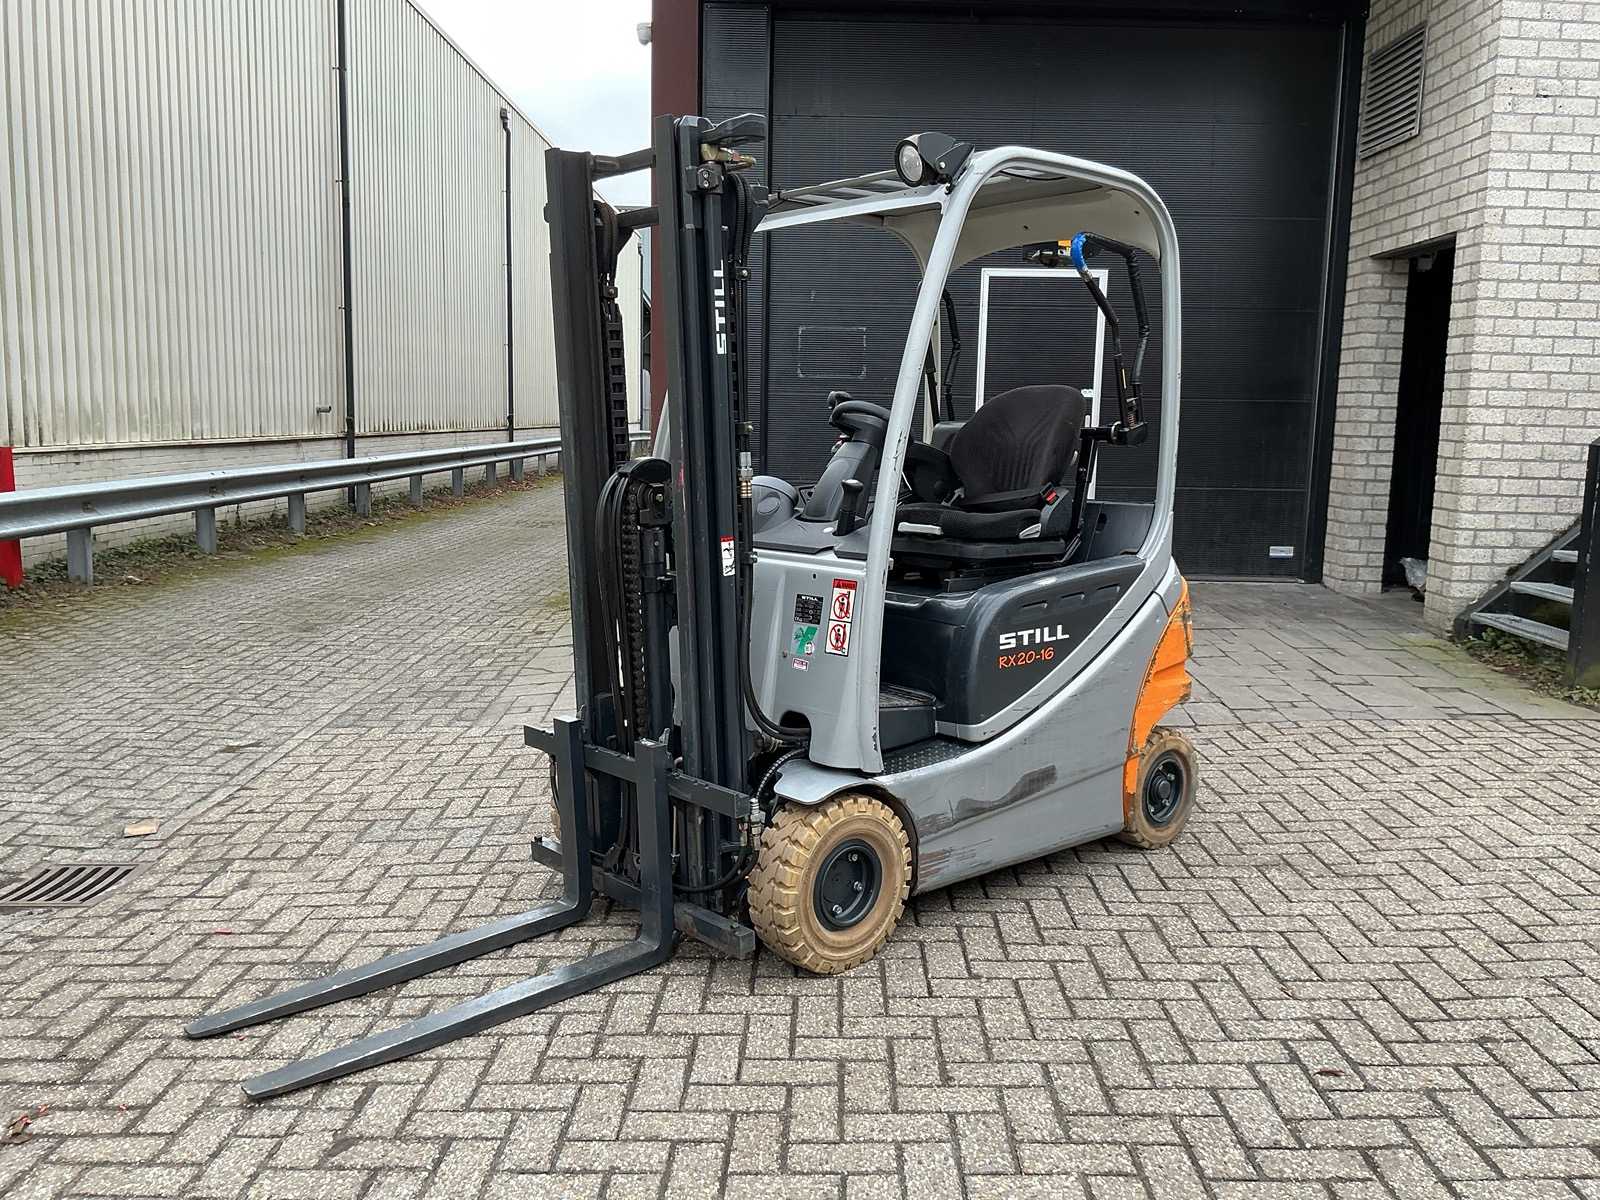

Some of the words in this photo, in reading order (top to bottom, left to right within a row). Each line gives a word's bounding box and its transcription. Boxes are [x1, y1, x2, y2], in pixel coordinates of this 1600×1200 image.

[713, 259, 727, 354] STILL
[999, 624, 1070, 650] STILL
[998, 647, 1054, 669] RX20-16
